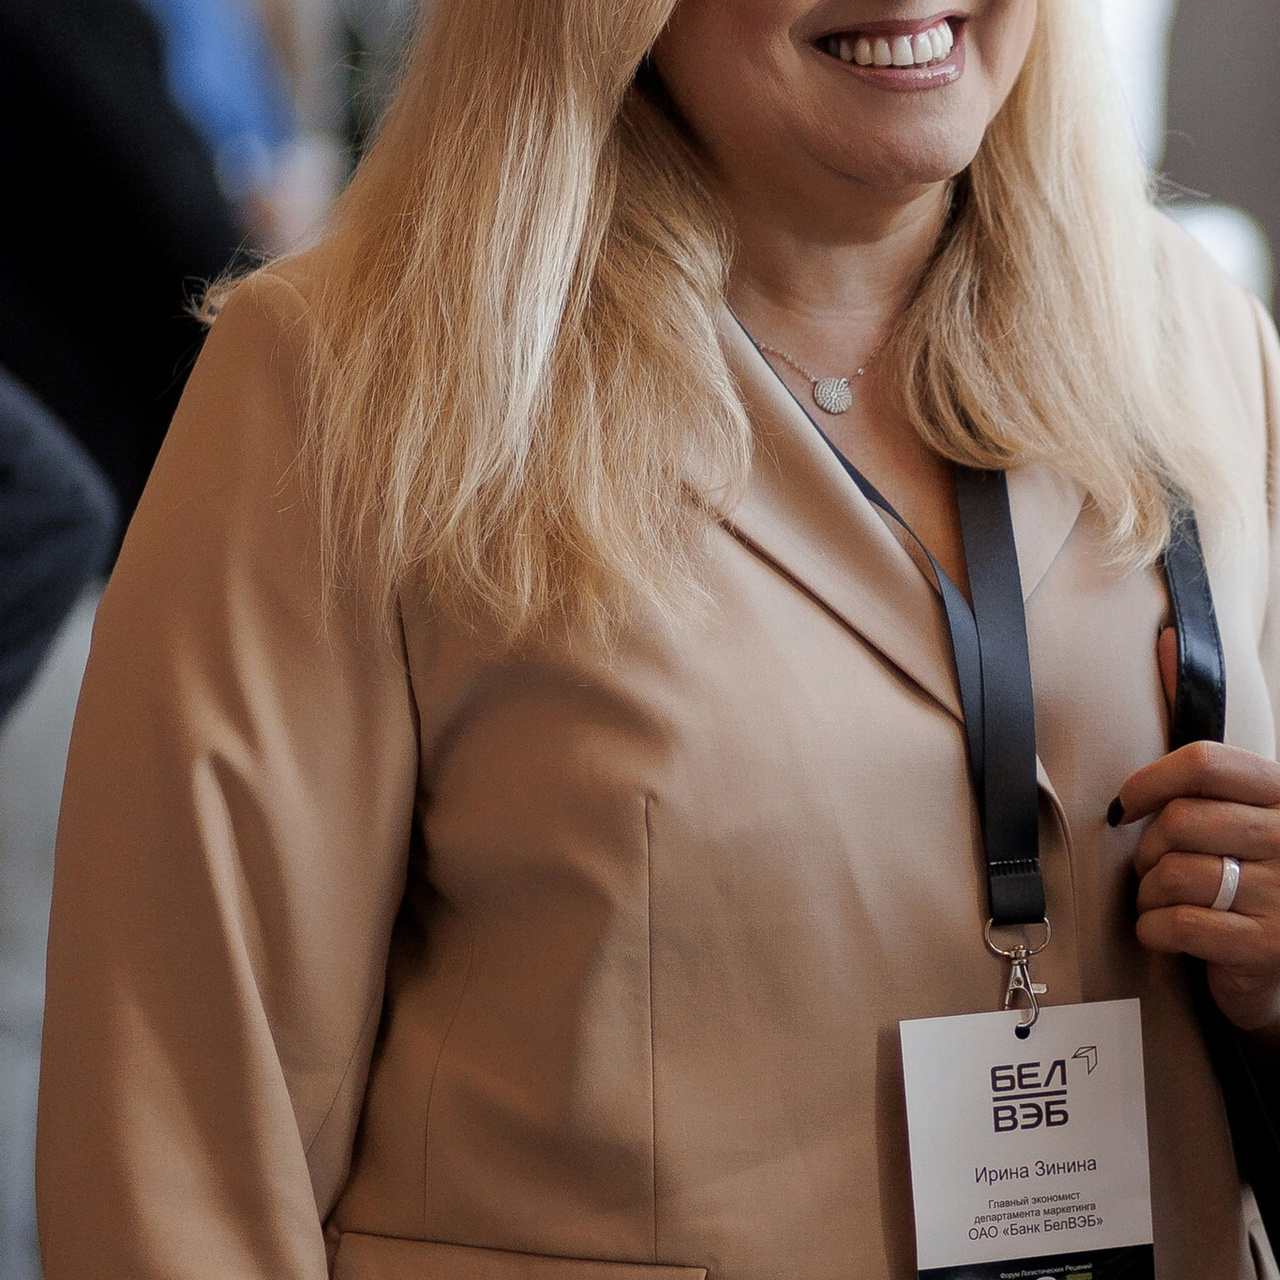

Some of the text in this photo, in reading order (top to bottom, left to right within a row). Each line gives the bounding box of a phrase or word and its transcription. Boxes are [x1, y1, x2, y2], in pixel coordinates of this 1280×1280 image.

[990, 1059, 1068, 1092] БЕЛ
[992, 1099, 1069, 1133] ВЭБ
[974, 1158, 1098, 1186] Ирина Зинина
[973, 1202, 1097, 1225] департамента маркетинга
[988, 1192, 1081, 1209] Главный экономист
[968, 1214, 1104, 1241] ОАО «Банк БелВЭБ»
